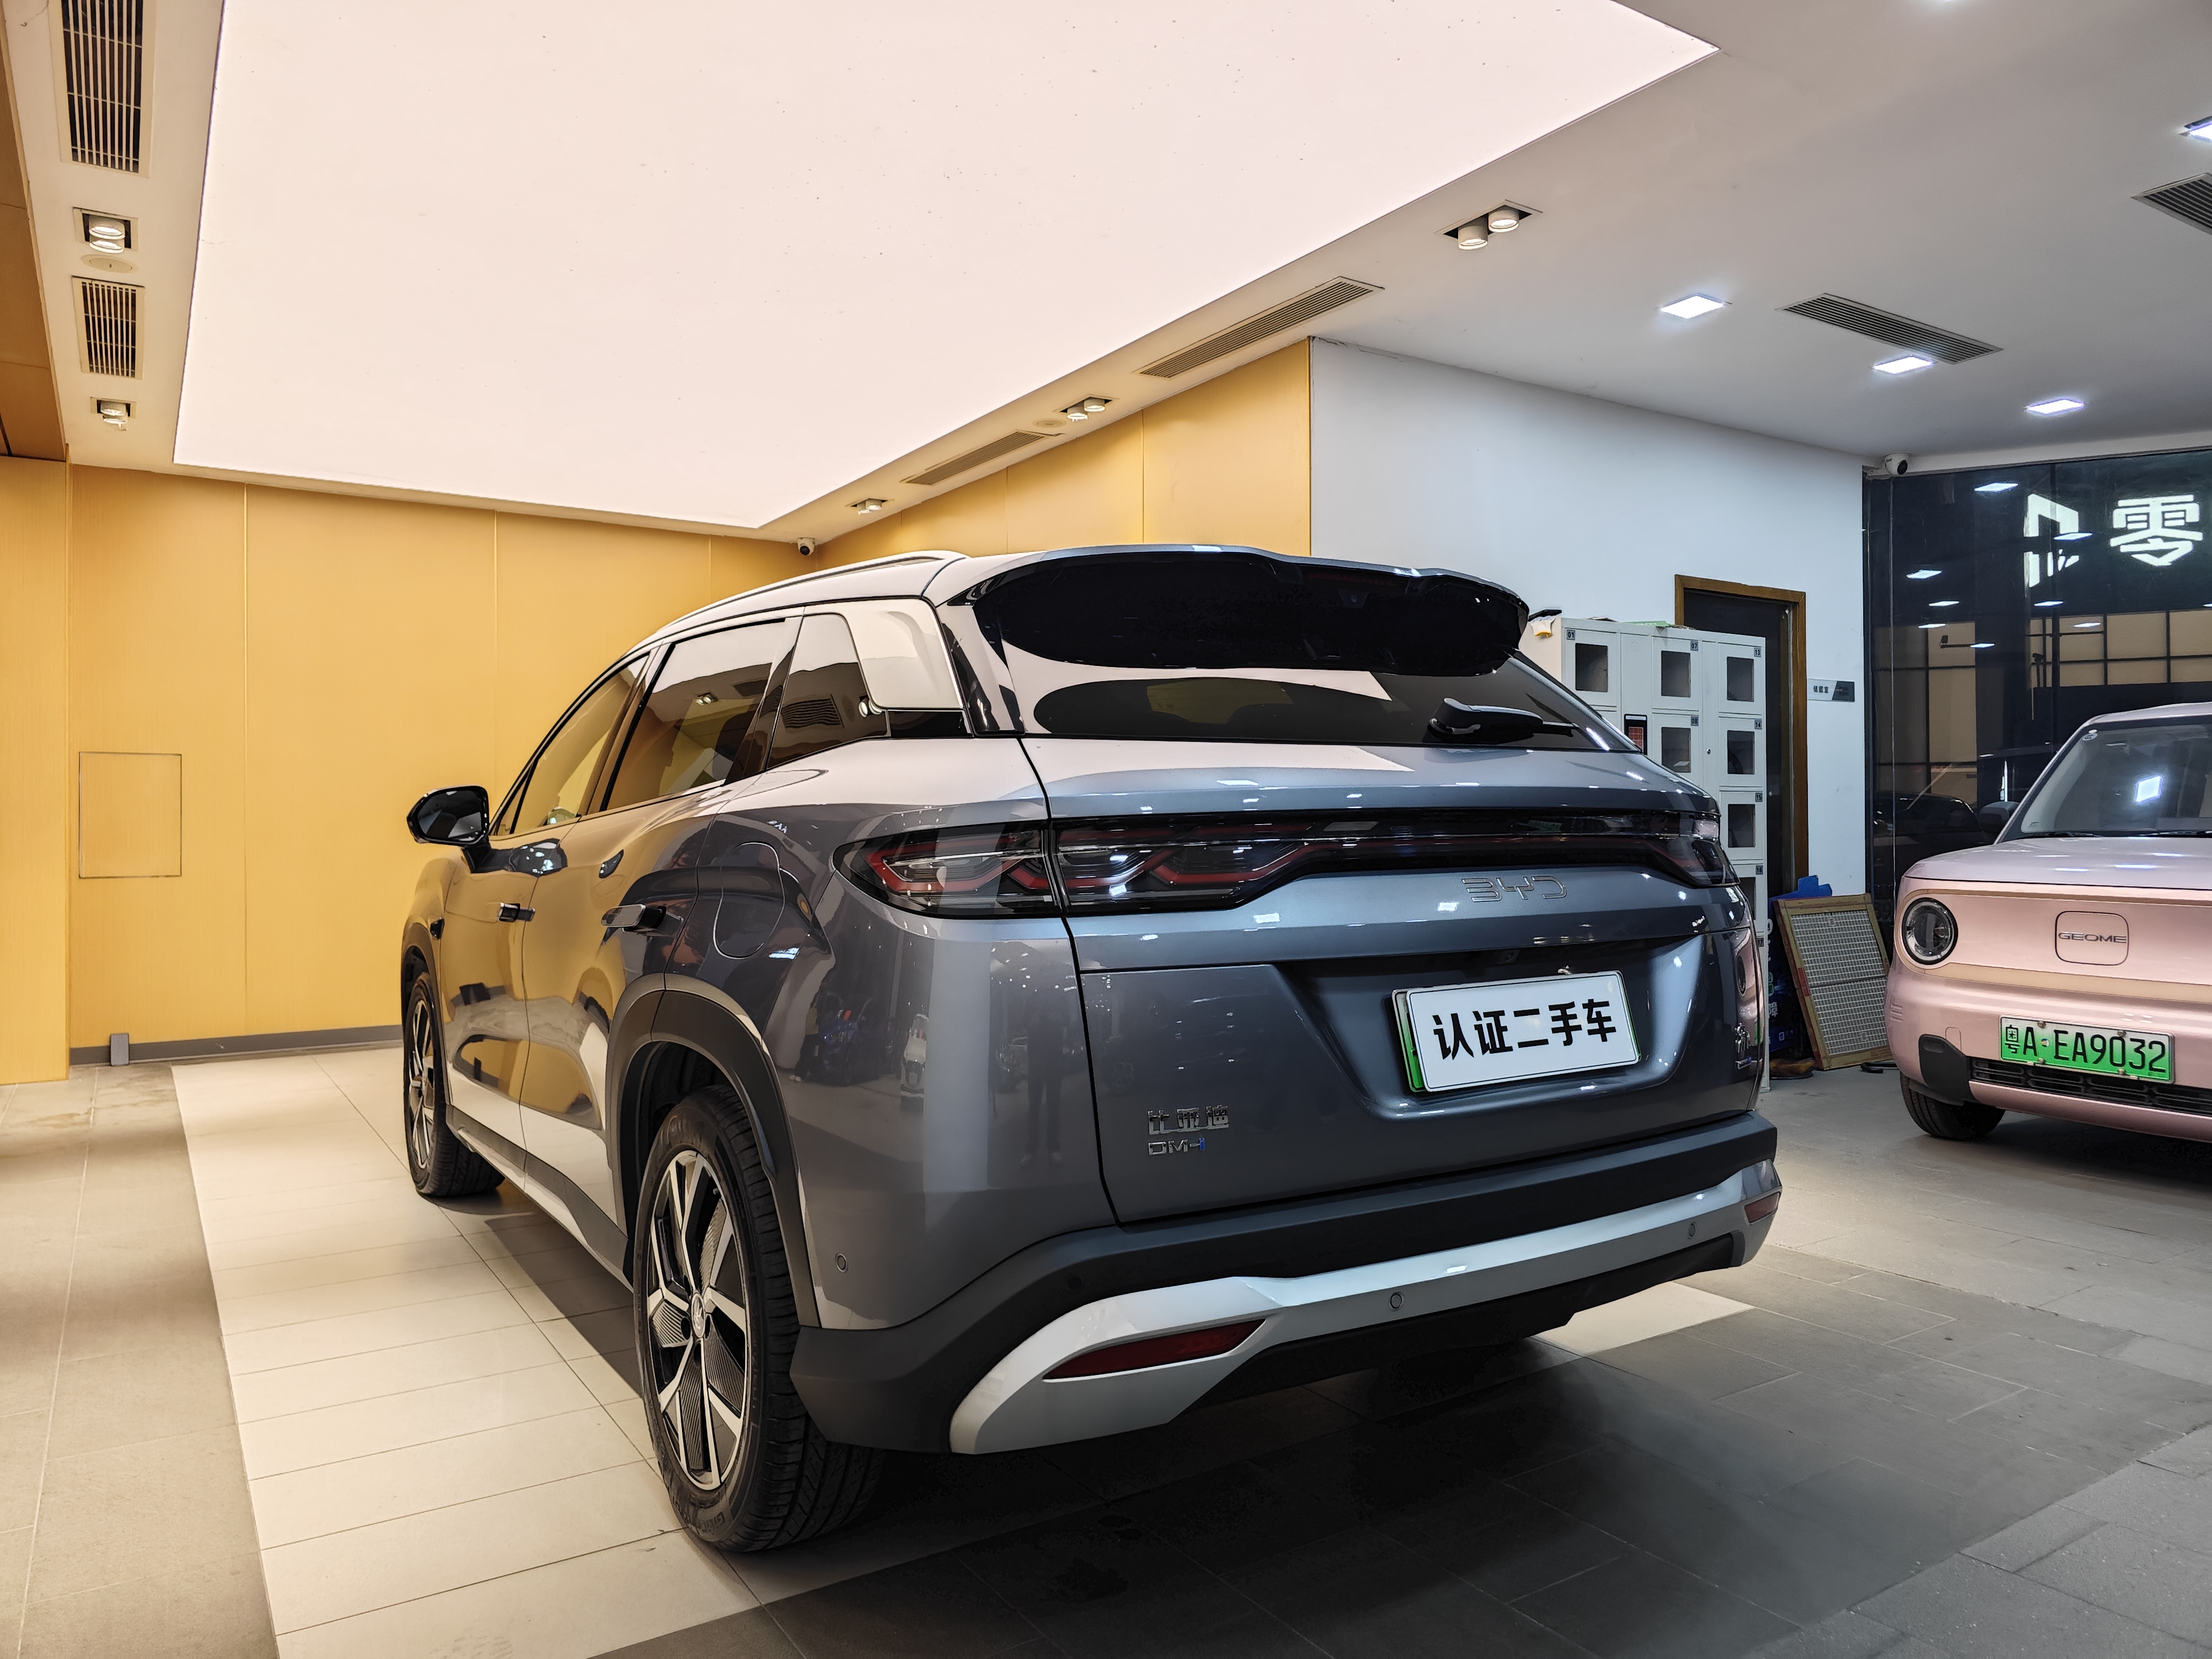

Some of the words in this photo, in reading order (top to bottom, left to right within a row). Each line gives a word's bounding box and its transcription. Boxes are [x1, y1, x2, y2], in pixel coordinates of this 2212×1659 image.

[2110, 494, 2203, 567] 零
[1461, 875, 1567, 902] BYD
[2058, 931, 2127, 945] GEOME
[1432, 998, 1616, 1061] 认证二手车
[1148, 1104, 1229, 1135] 比亚迪
